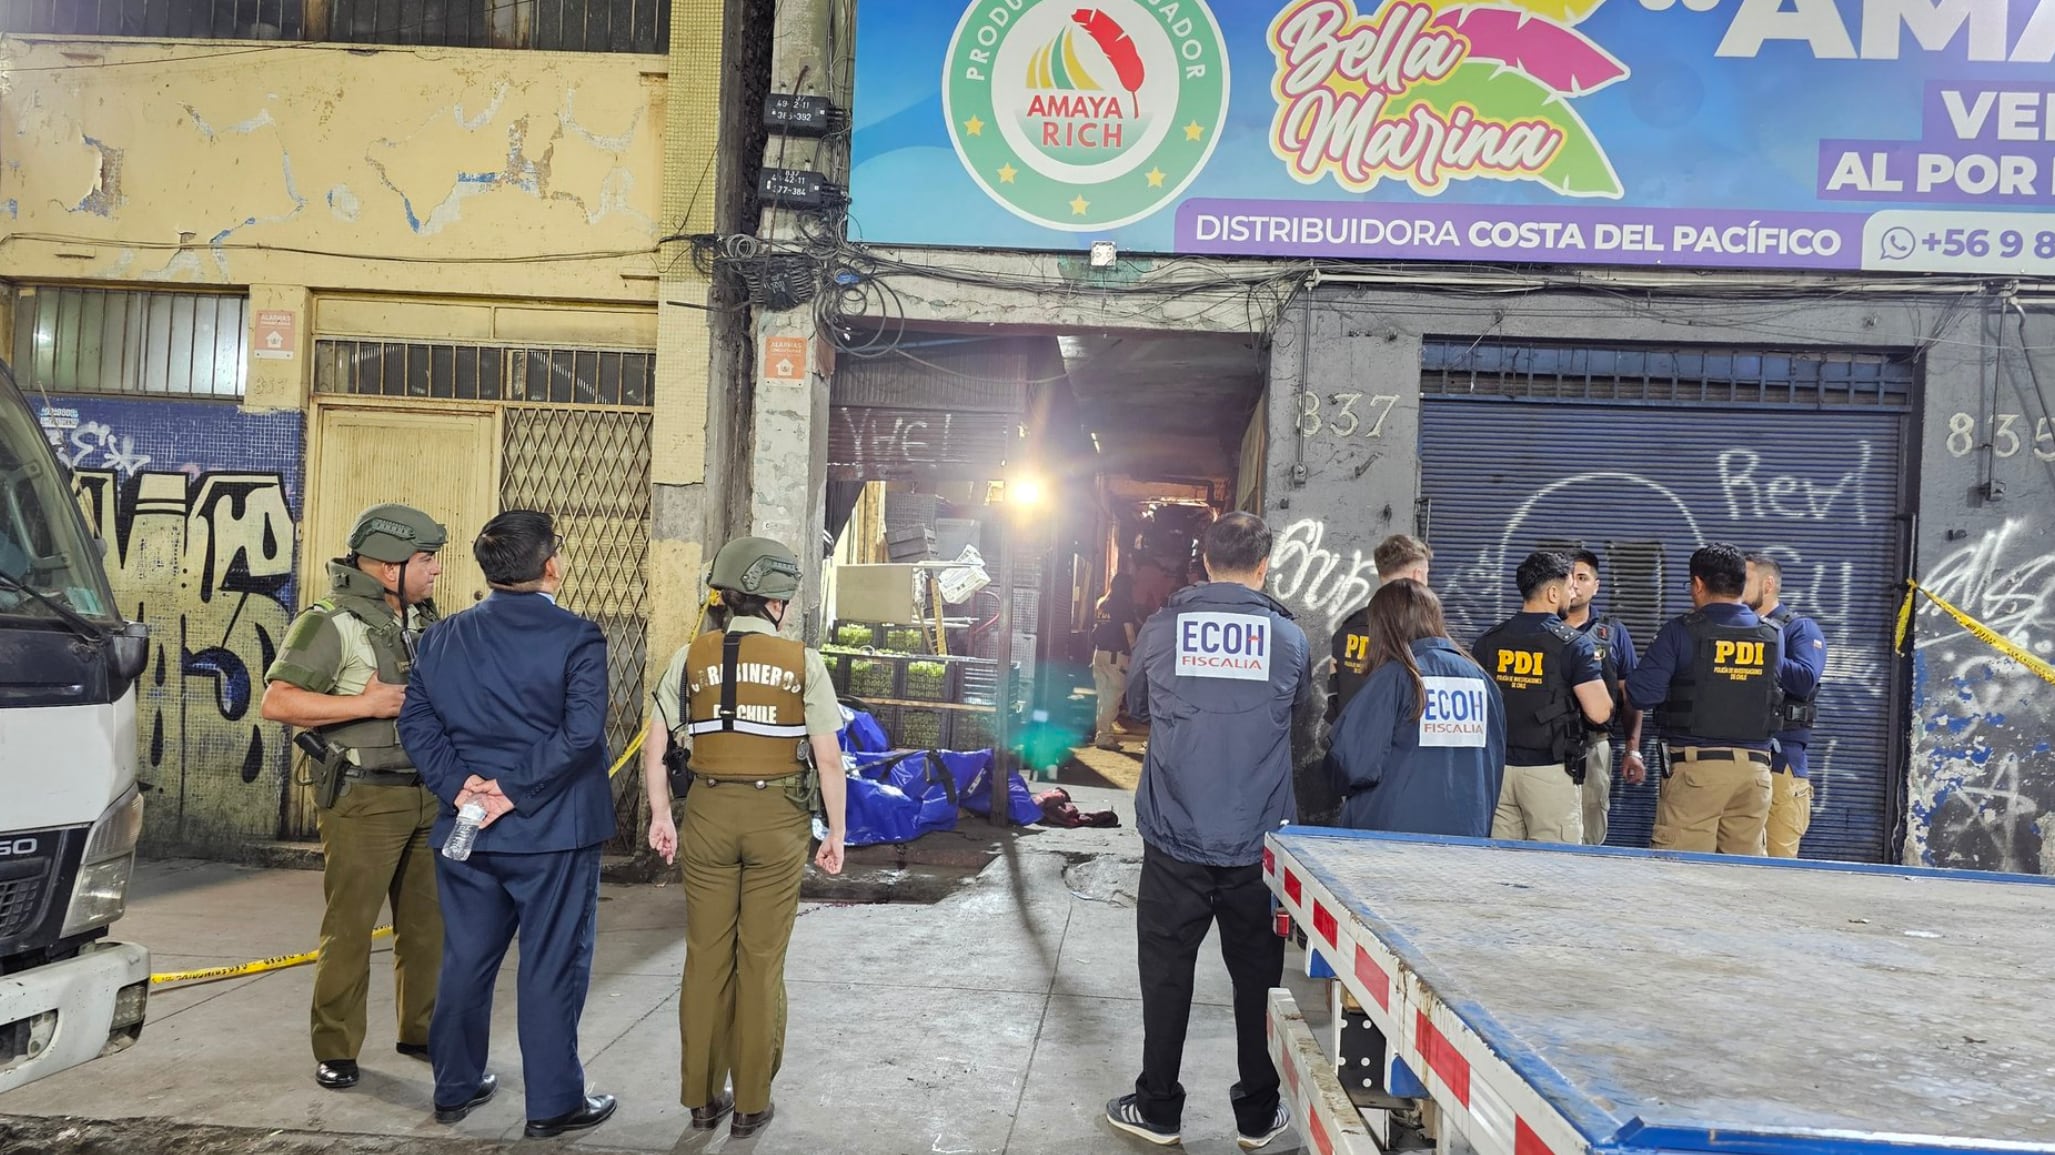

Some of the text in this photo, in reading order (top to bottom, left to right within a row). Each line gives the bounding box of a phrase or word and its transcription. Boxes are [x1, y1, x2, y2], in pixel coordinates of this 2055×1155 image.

[1280, 2, 1463, 95] Bella
[1027, 95, 1123, 118] AMAYA
[1043, 121, 1122, 147] RICH
[1282, 89, 1560, 184] Marina
[1826, 152, 1903, 191] AL
[1917, 154, 2037, 195] POR
[1196, 214, 1842, 256] DISTRIBUIDORA COSTA DEL PACÍFICO
[1922, 229, 1990, 257] +56
[1999, 230, 2023, 258] 9
[1296, 391, 1400, 438] 837
[1183, 621, 1264, 656] ECOH
[1714, 640, 1765, 665] PDI
[1182, 656, 1262, 670] FISCALIA
[1497, 649, 1543, 675] PDI
[736, 704, 777, 724] CHILE
[1425, 689, 1483, 722] ECOH
[1424, 723, 1484, 734] FISCALIA
